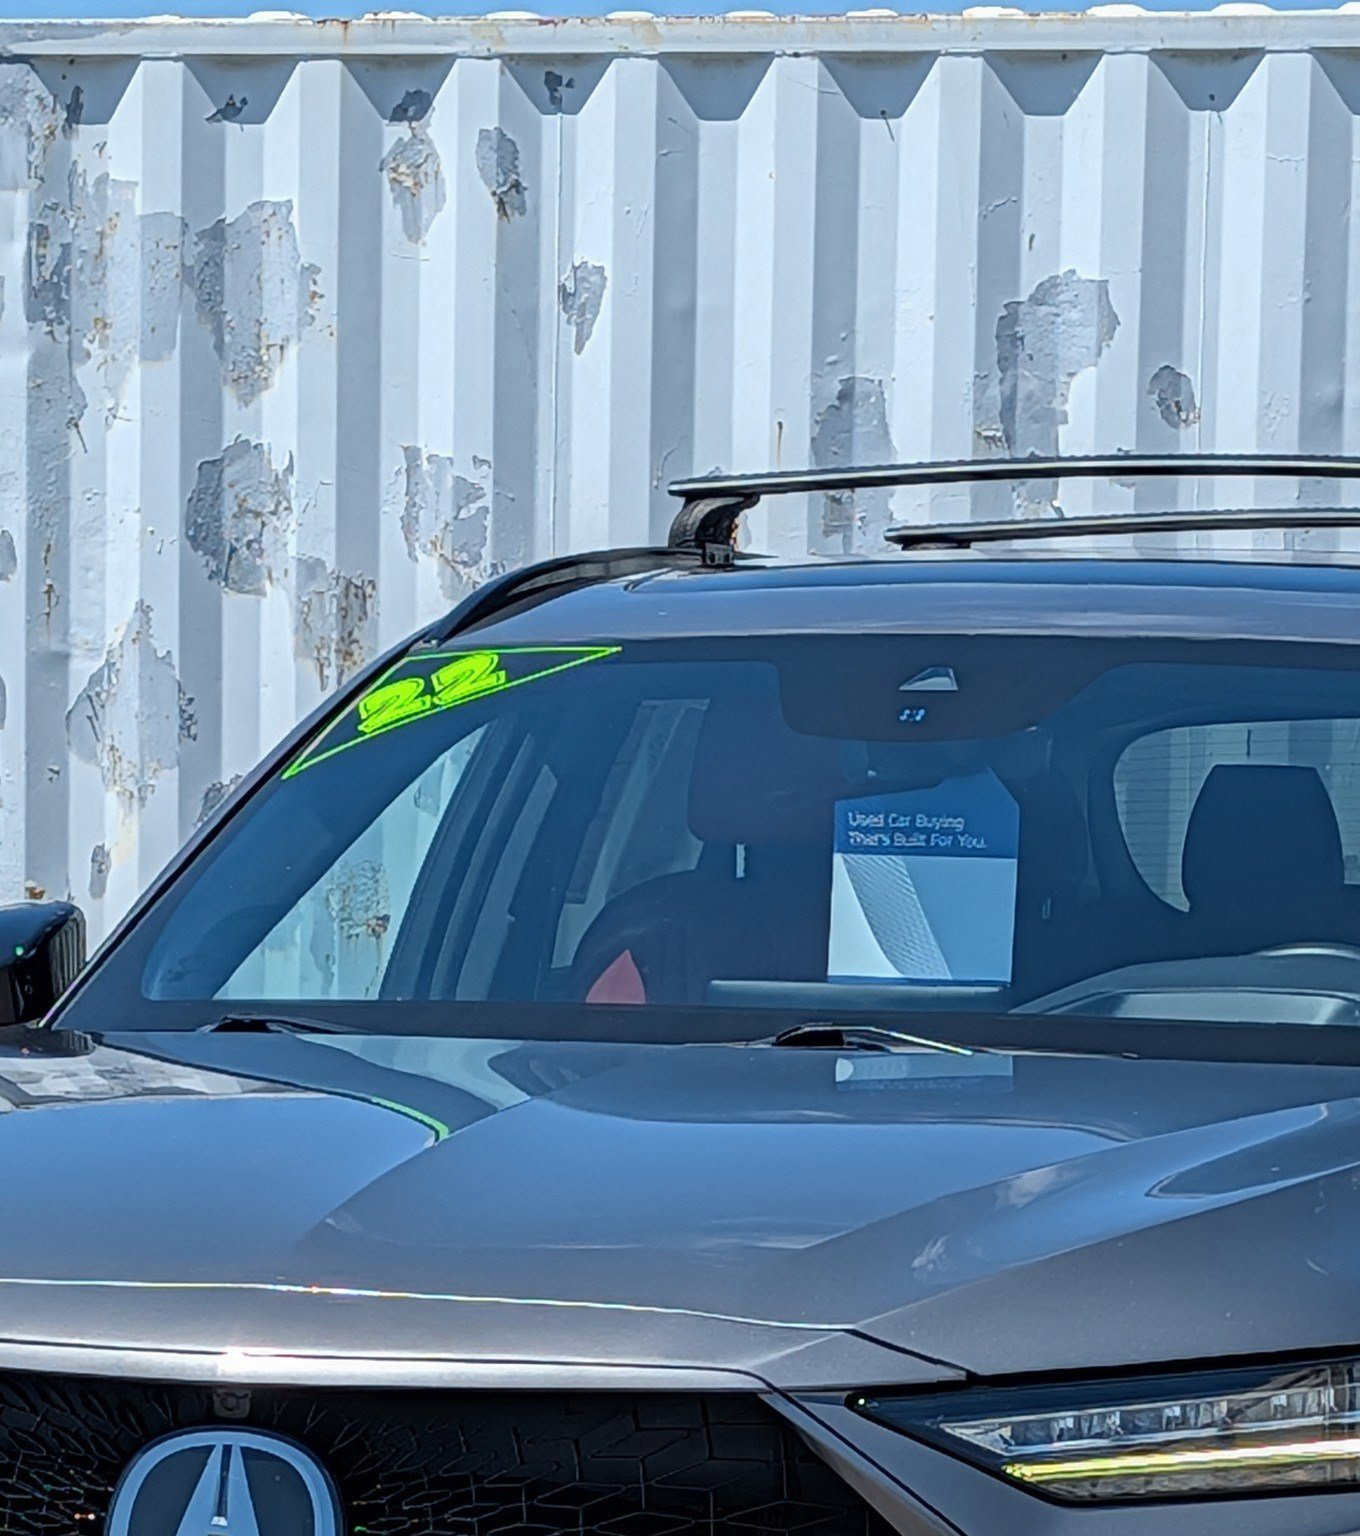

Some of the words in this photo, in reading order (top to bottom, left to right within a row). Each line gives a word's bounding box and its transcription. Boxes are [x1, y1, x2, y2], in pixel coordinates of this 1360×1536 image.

[357, 652, 506, 734] 22
[848, 811, 885, 827] Used
[888, 813, 912, 828] Car
[915, 813, 965, 832] Buying
[848, 831, 890, 846] That's
[930, 833, 954, 847] For
